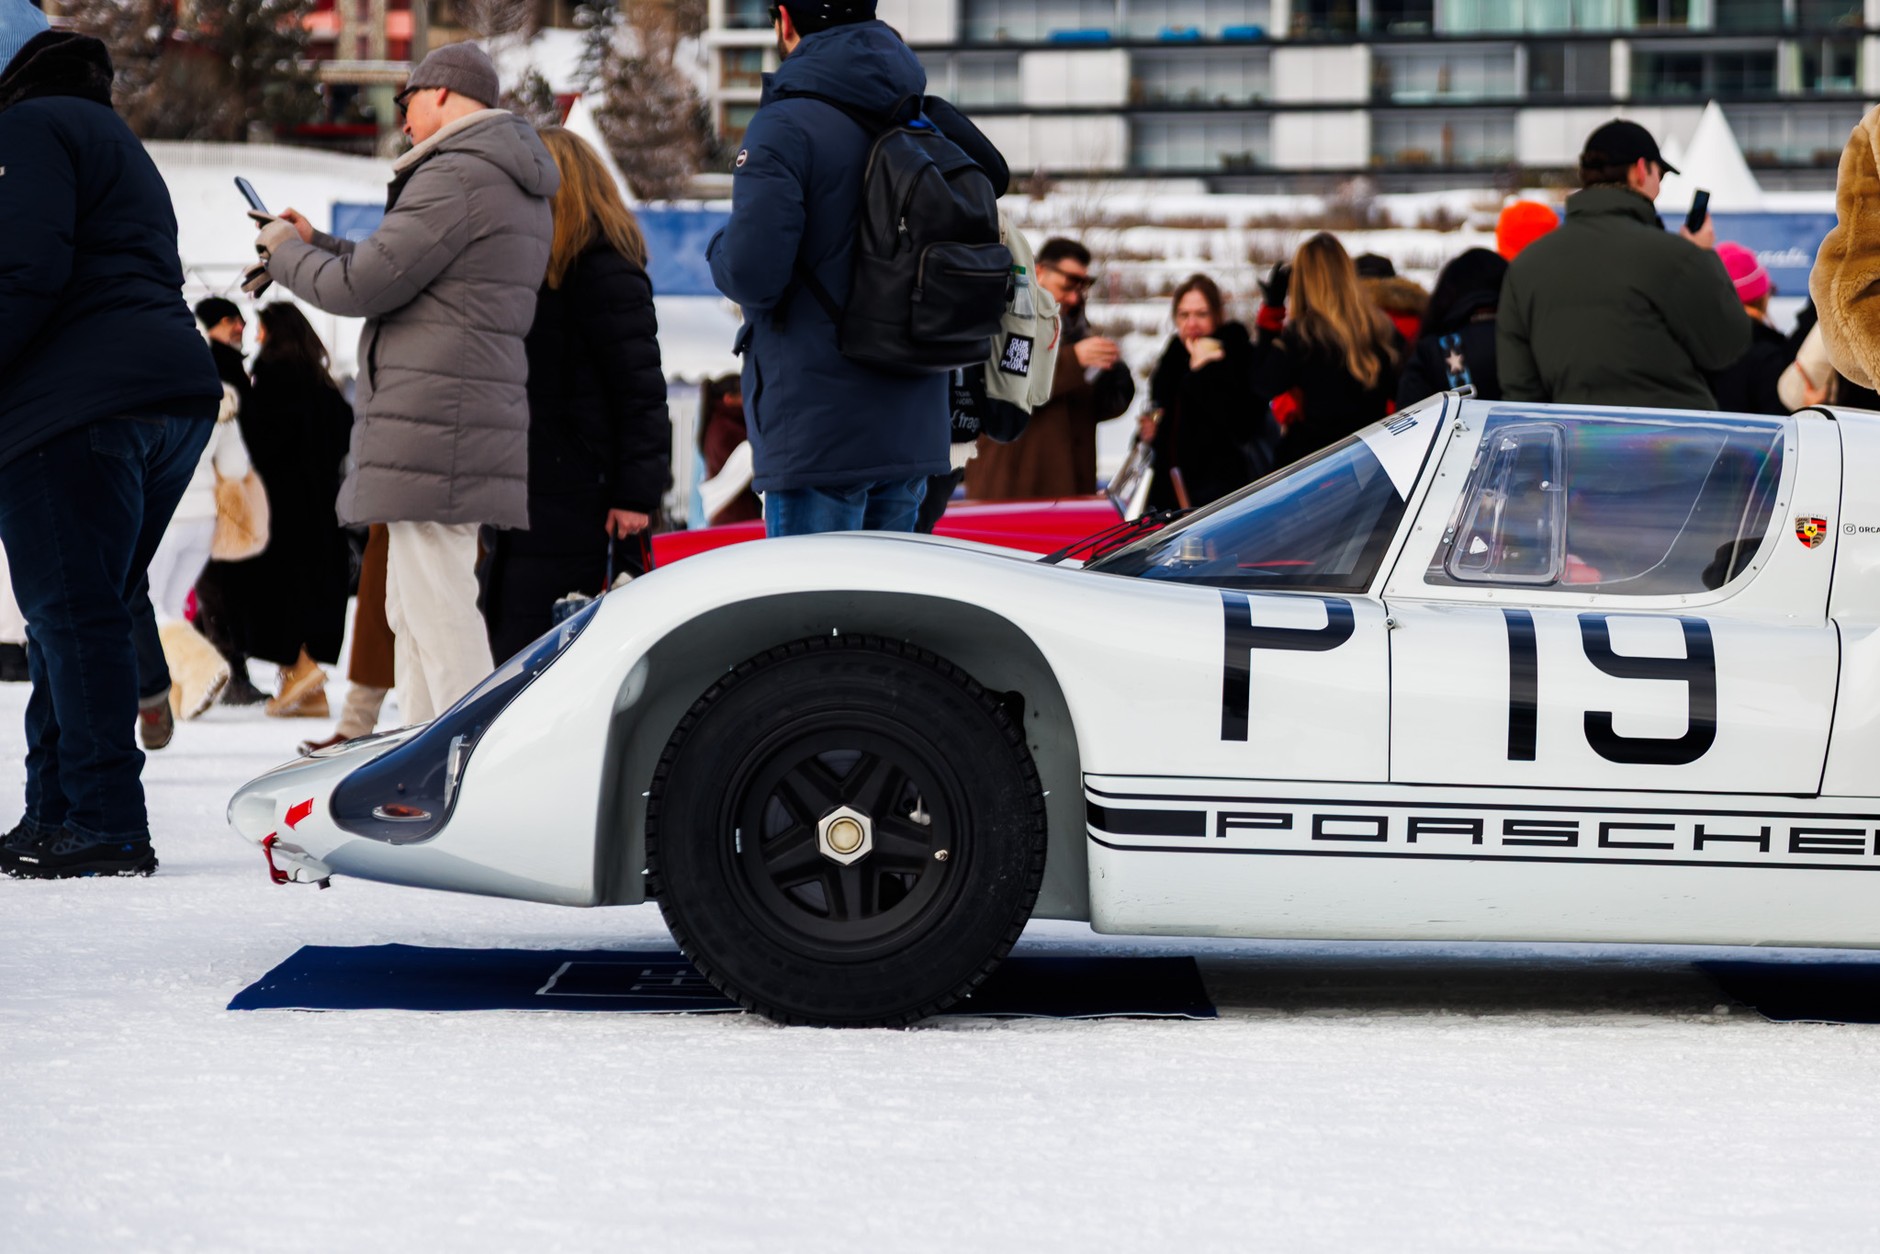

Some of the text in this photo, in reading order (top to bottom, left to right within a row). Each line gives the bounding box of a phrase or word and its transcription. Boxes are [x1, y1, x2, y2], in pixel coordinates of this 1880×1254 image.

[1001, 360, 1027, 373] PEOPLE
[1010, 356, 1024, 364] THE
[1216, 809, 1866, 856] PORSCHE
